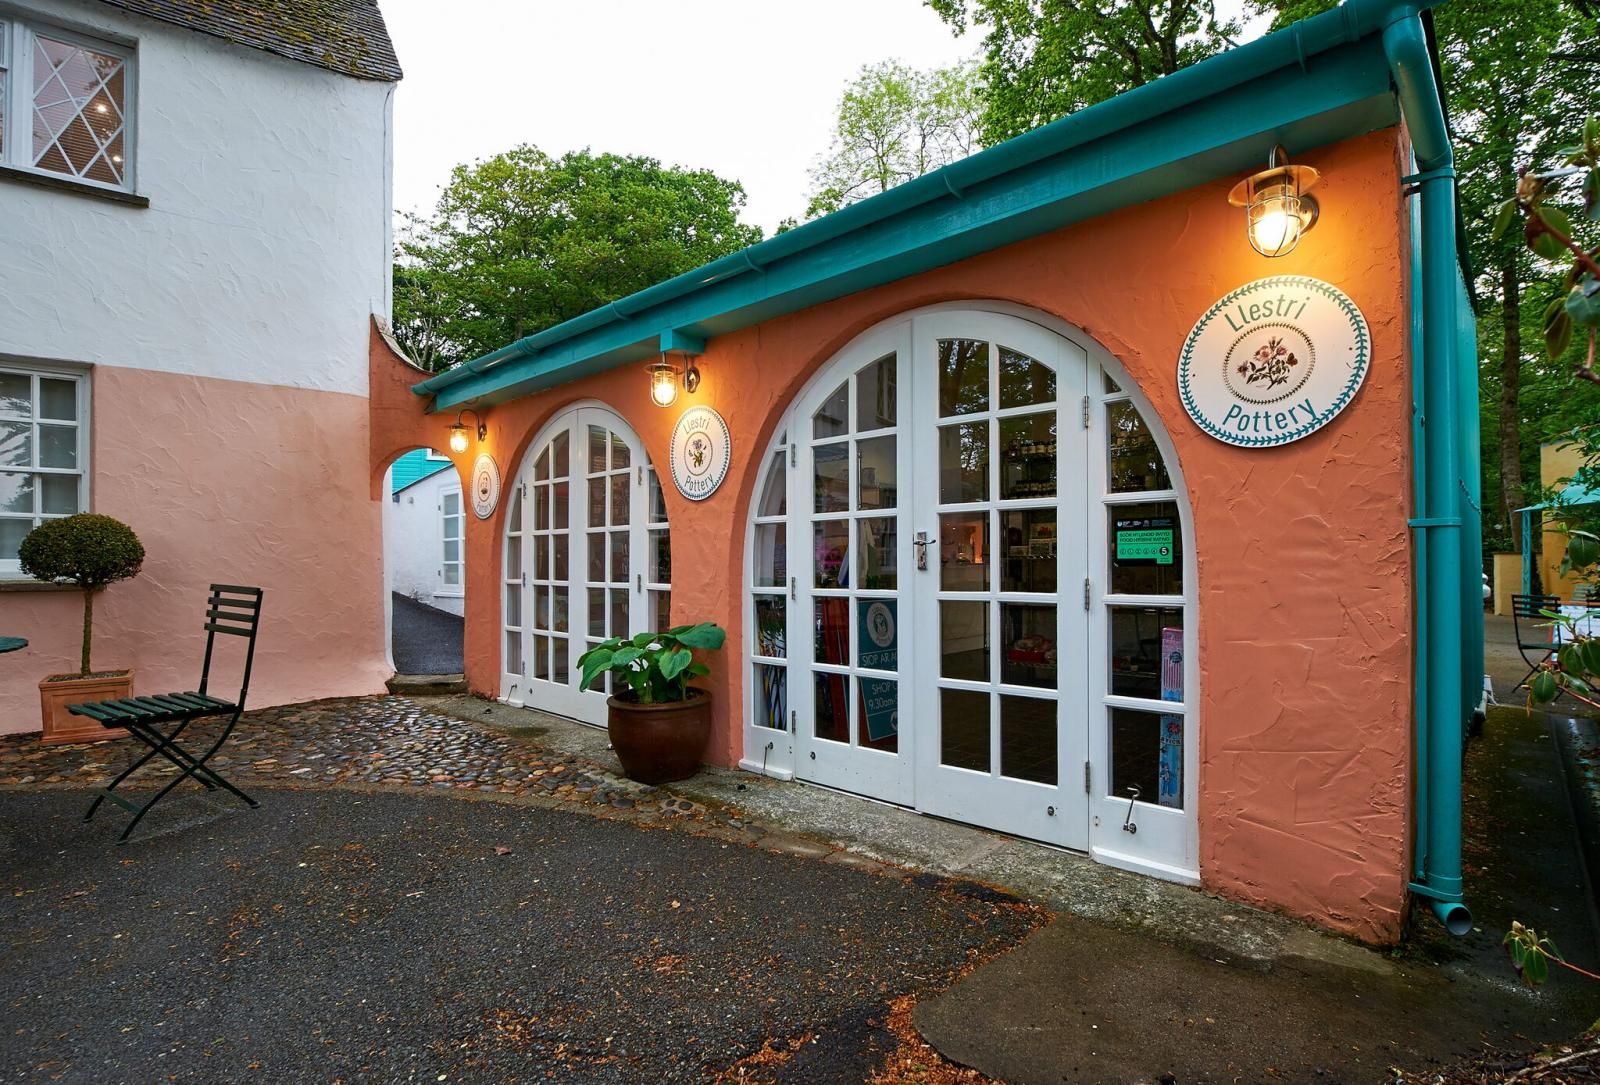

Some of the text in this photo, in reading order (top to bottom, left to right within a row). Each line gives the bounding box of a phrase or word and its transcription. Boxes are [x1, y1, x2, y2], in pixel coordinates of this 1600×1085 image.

[1224, 294, 1310, 332] Llestri
[1222, 398, 1317, 432] Pottery
[683, 416, 710, 435] Llestri
[684, 474, 714, 491] Pottery
[1161, 547, 1168, 555] 5
[871, 681, 891, 695] SHOP
